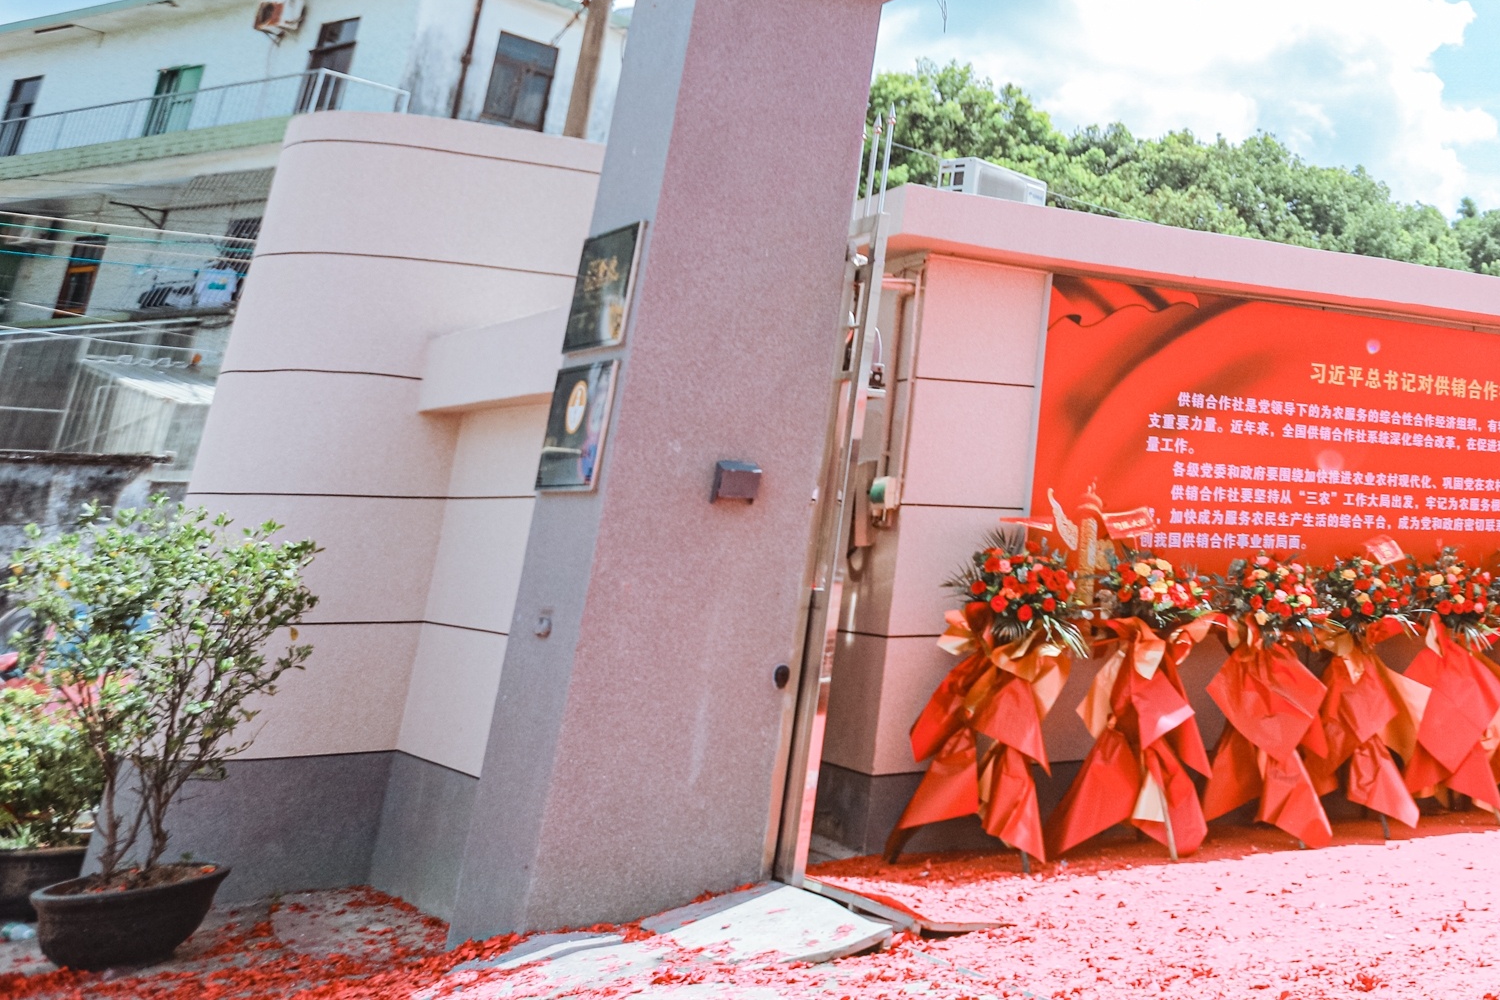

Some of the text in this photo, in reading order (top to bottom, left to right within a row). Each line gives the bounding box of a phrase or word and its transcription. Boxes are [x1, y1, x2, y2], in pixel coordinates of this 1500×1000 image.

[1146, 436, 1195, 454] 量工作。
[1140, 532, 1307, 549] 创我国供销合作事业新局面。
